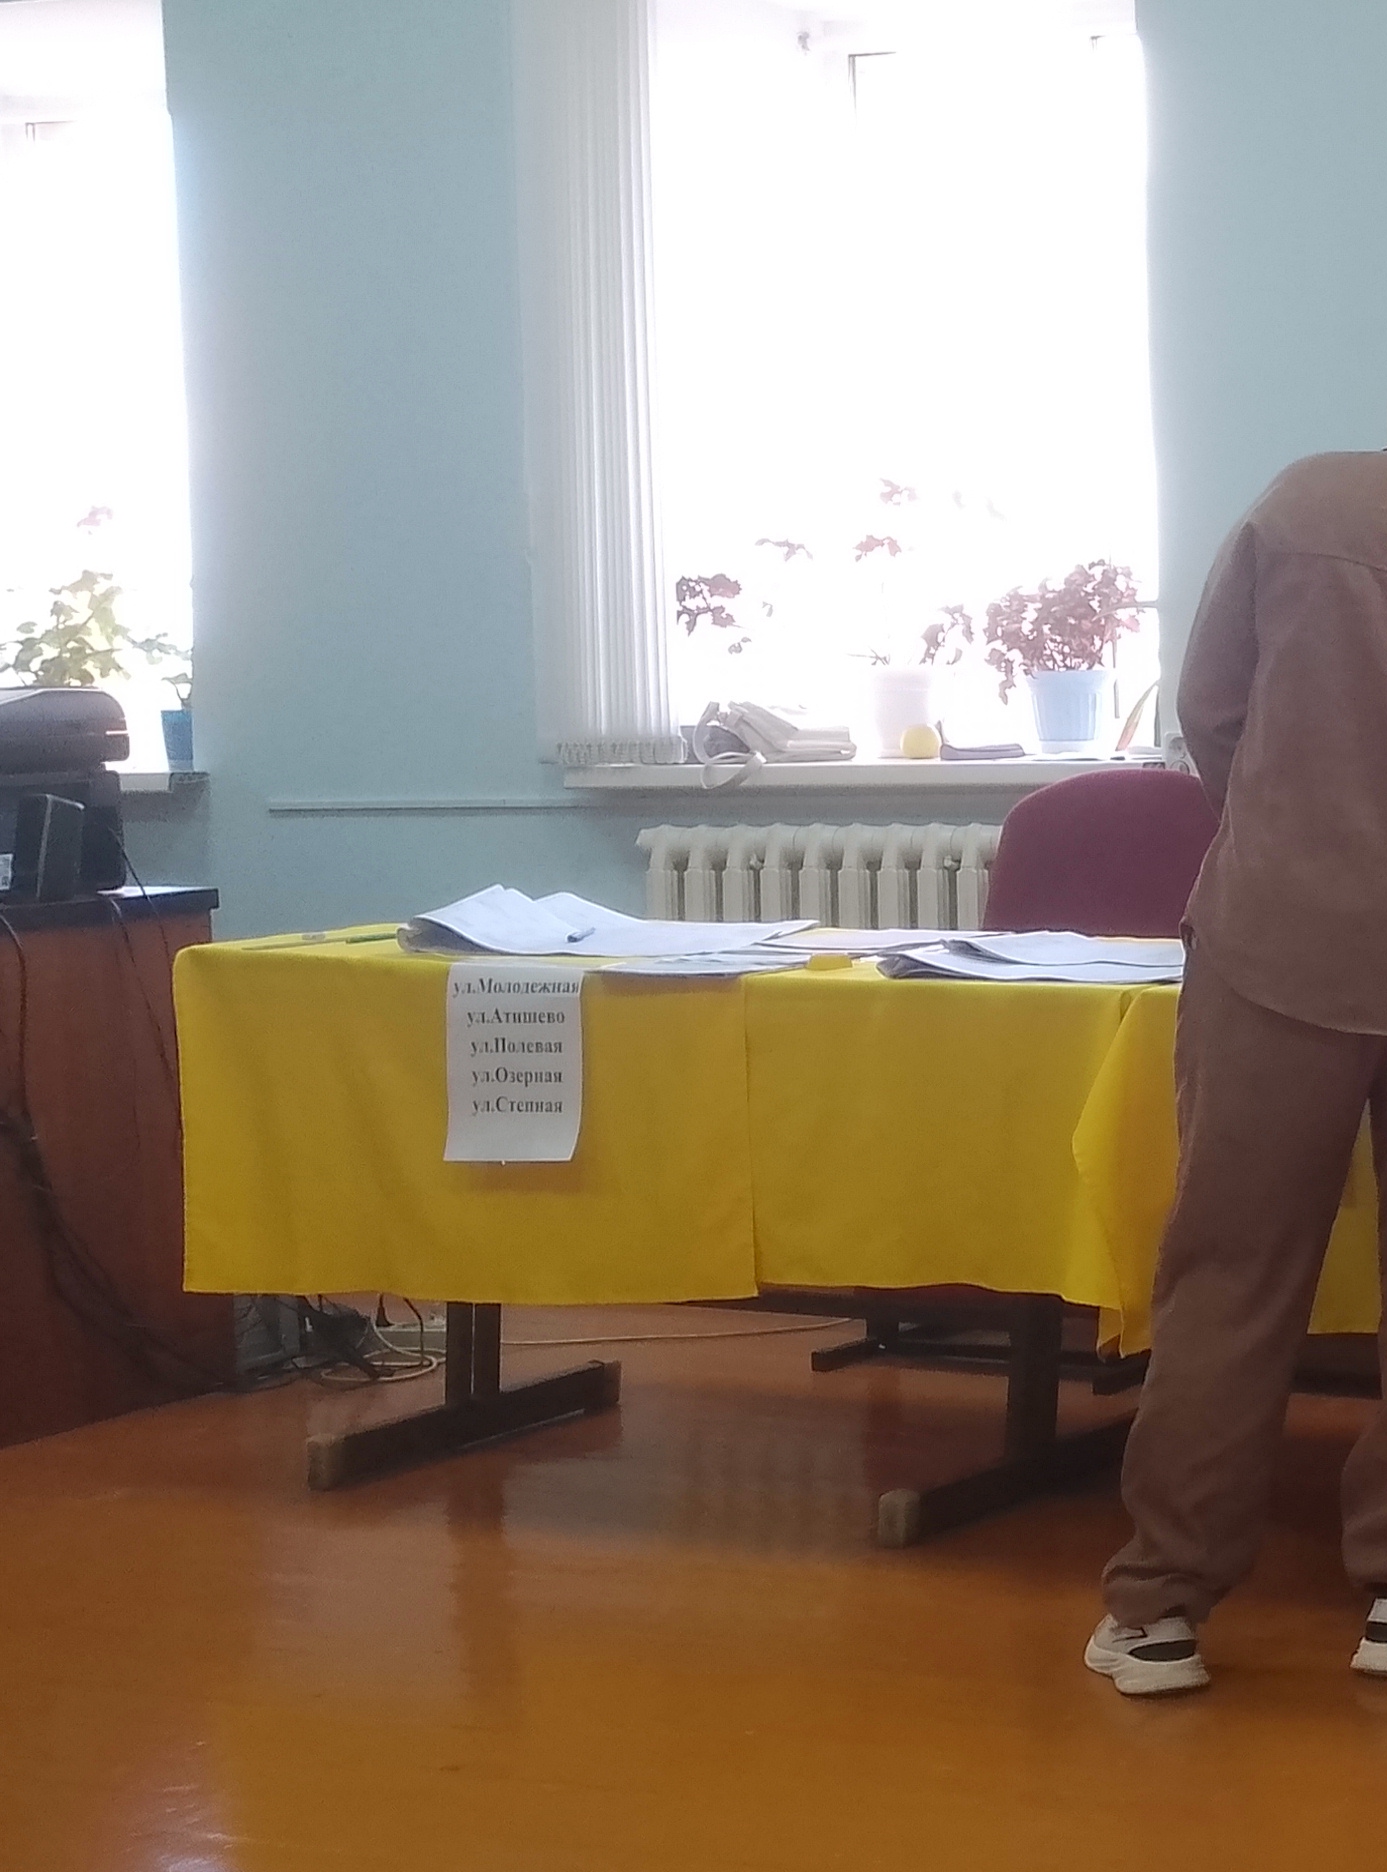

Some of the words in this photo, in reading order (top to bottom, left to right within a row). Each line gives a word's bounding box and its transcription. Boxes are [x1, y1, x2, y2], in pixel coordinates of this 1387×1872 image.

[470, 1037, 563, 1057] ул.Полевая
[471, 1066, 563, 1087] ул.Озерная
[471, 1096, 563, 1116] ул.Степная
